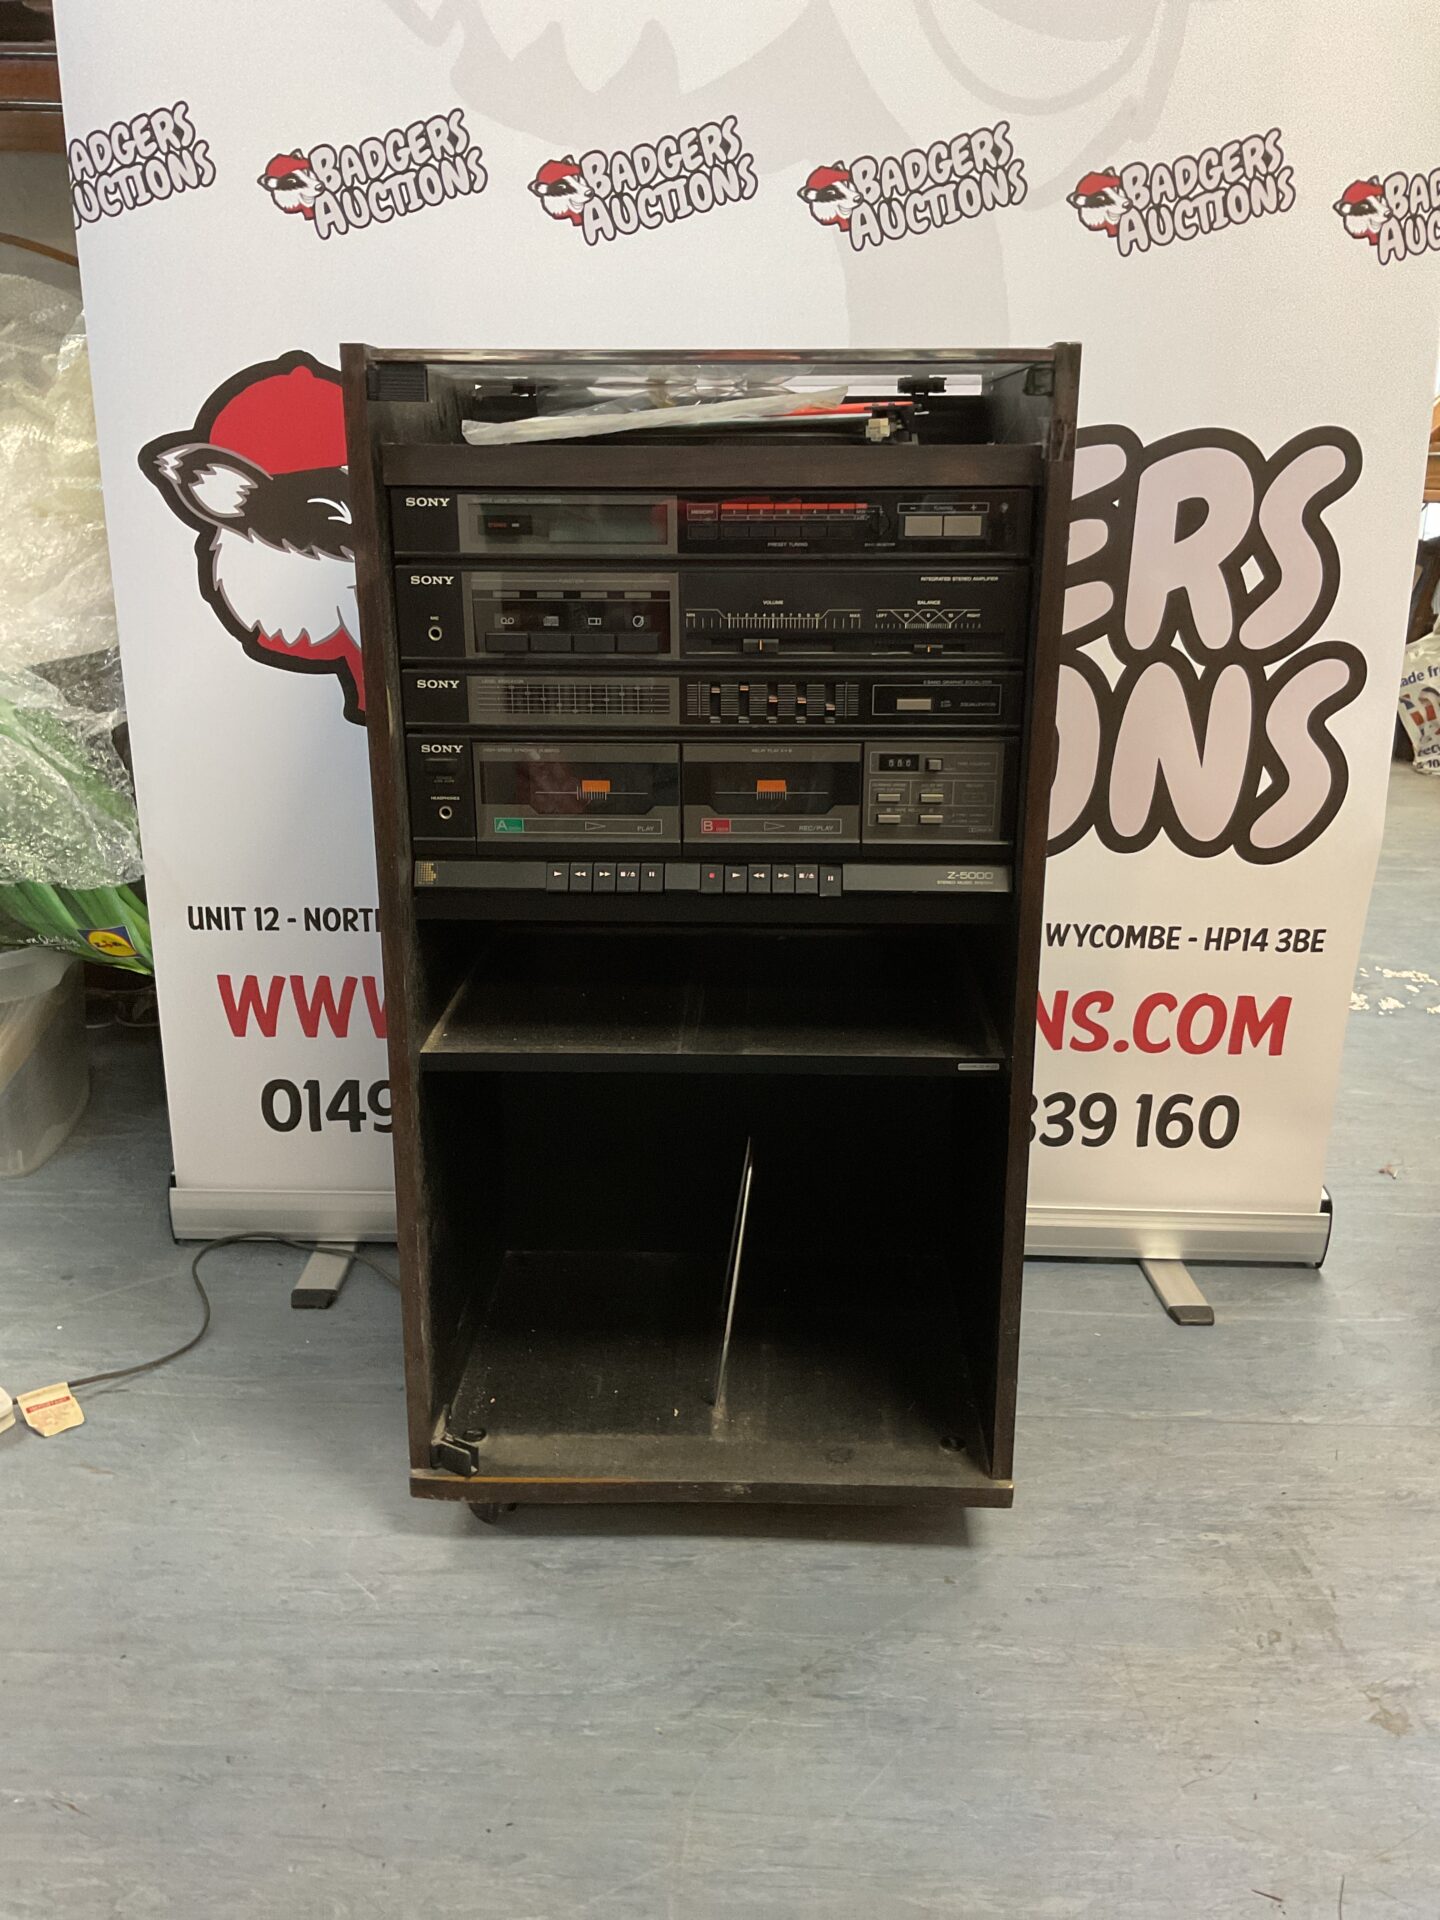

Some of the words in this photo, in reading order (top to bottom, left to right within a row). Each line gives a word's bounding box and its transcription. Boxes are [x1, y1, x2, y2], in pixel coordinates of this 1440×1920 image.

[67, 101, 196, 182] ADGERS
[309, 108, 470, 193] BADGERS
[580, 115, 742, 200] BADGERS
[850, 120, 1014, 206] BADGERS
[1118, 127, 1285, 212] BADGERS
[71, 140, 216, 229] UCTIONS
[313, 146, 488, 239] AUCTIONS
[581, 153, 759, 246] AUCTIONS
[849, 159, 1028, 251] AUCTIONS
[1117, 165, 1295, 257] AUCTIONS
[405, 497, 450, 507] SONY
[410, 575, 455, 585] SONY
[416, 679, 460, 689] SONY
[421, 744, 464, 754] SONY
[496, 820, 508, 831] A
[703, 820, 713, 831] B
[947, 871, 994, 880] Z-5000
[187, 905, 246, 931] UNIT
[254, 906, 280, 931] 12
[1045, 923, 1182, 950] WYCOMBE
[1204, 927, 1268, 953] HP14
[1275, 928, 1327, 953] 3BE
[1029, 1091, 1118, 1148] 39
[1136, 1093, 1240, 1149] 160
